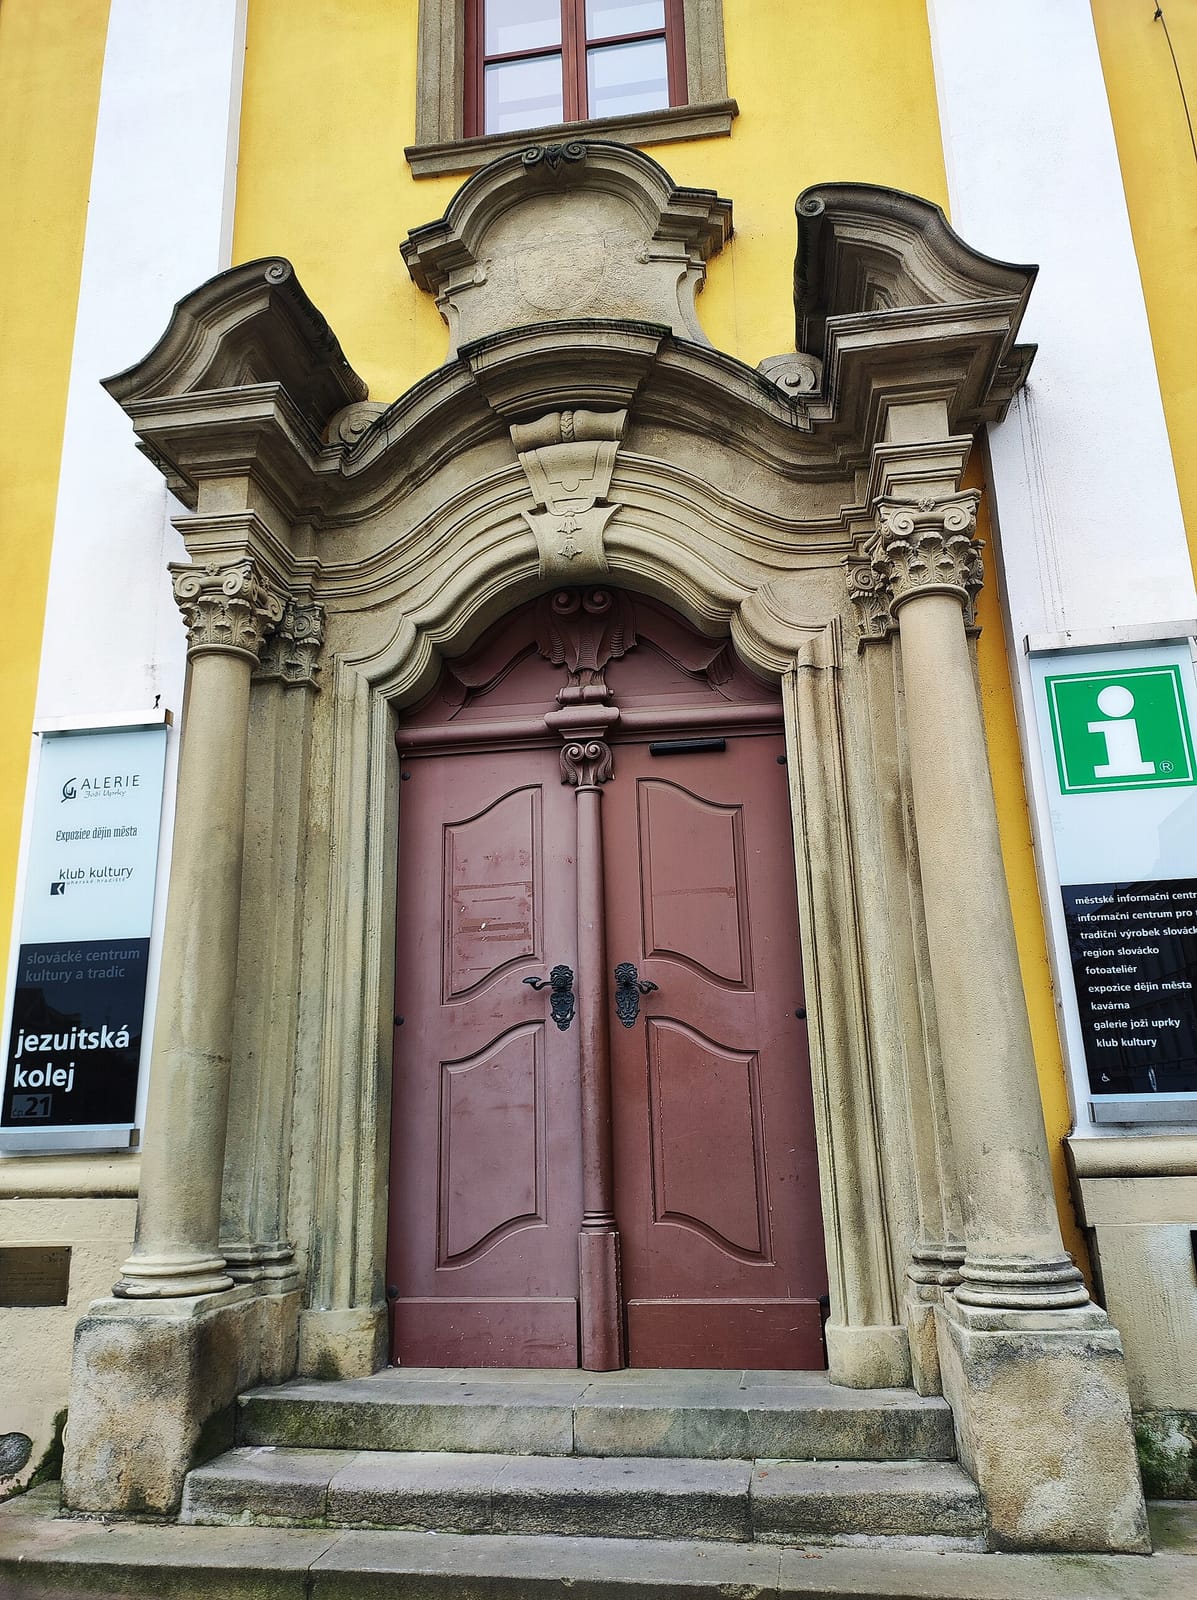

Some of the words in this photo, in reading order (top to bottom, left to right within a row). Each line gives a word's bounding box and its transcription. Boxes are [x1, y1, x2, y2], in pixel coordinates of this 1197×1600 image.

[55, 829, 91, 842] Expozice
[92, 826, 112, 841] dějin
[113, 826, 138, 838] města
[59, 867, 85, 880] klub
[89, 866, 134, 879] kultury
[1075, 895, 1115, 905] městské
[1132, 910, 1173, 920] centrum
[1175, 909, 1193, 919] pro
[1120, 928, 1161, 939] výrobek
[27, 950, 83, 965] slovácké
[86, 949, 140, 962] centrum
[1083, 947, 1115, 958] region
[1117, 946, 1160, 956] slovácko
[25, 969, 72, 984] kultury
[75, 970, 83, 980] a
[87, 965, 126, 979] tradic
[1085, 964, 1138, 975] fotoateliér
[1088, 983, 1132, 994] expozice
[1133, 981, 1159, 993] dějin
[1161, 981, 1192, 990] města
[1090, 1001, 1130, 1011] kavárna
[1093, 1020, 1128, 1031] galerie
[1130, 1018, 1148, 1030] joži
[1151, 1018, 1180, 1029] uprky
[14, 1024, 130, 1059] jezuitská
[1096, 1038, 1119, 1048] klub
[1121, 1037, 1157, 1048] kultury
[13, 1062, 75, 1092] kolej
[25, 1096, 50, 1116] 21
